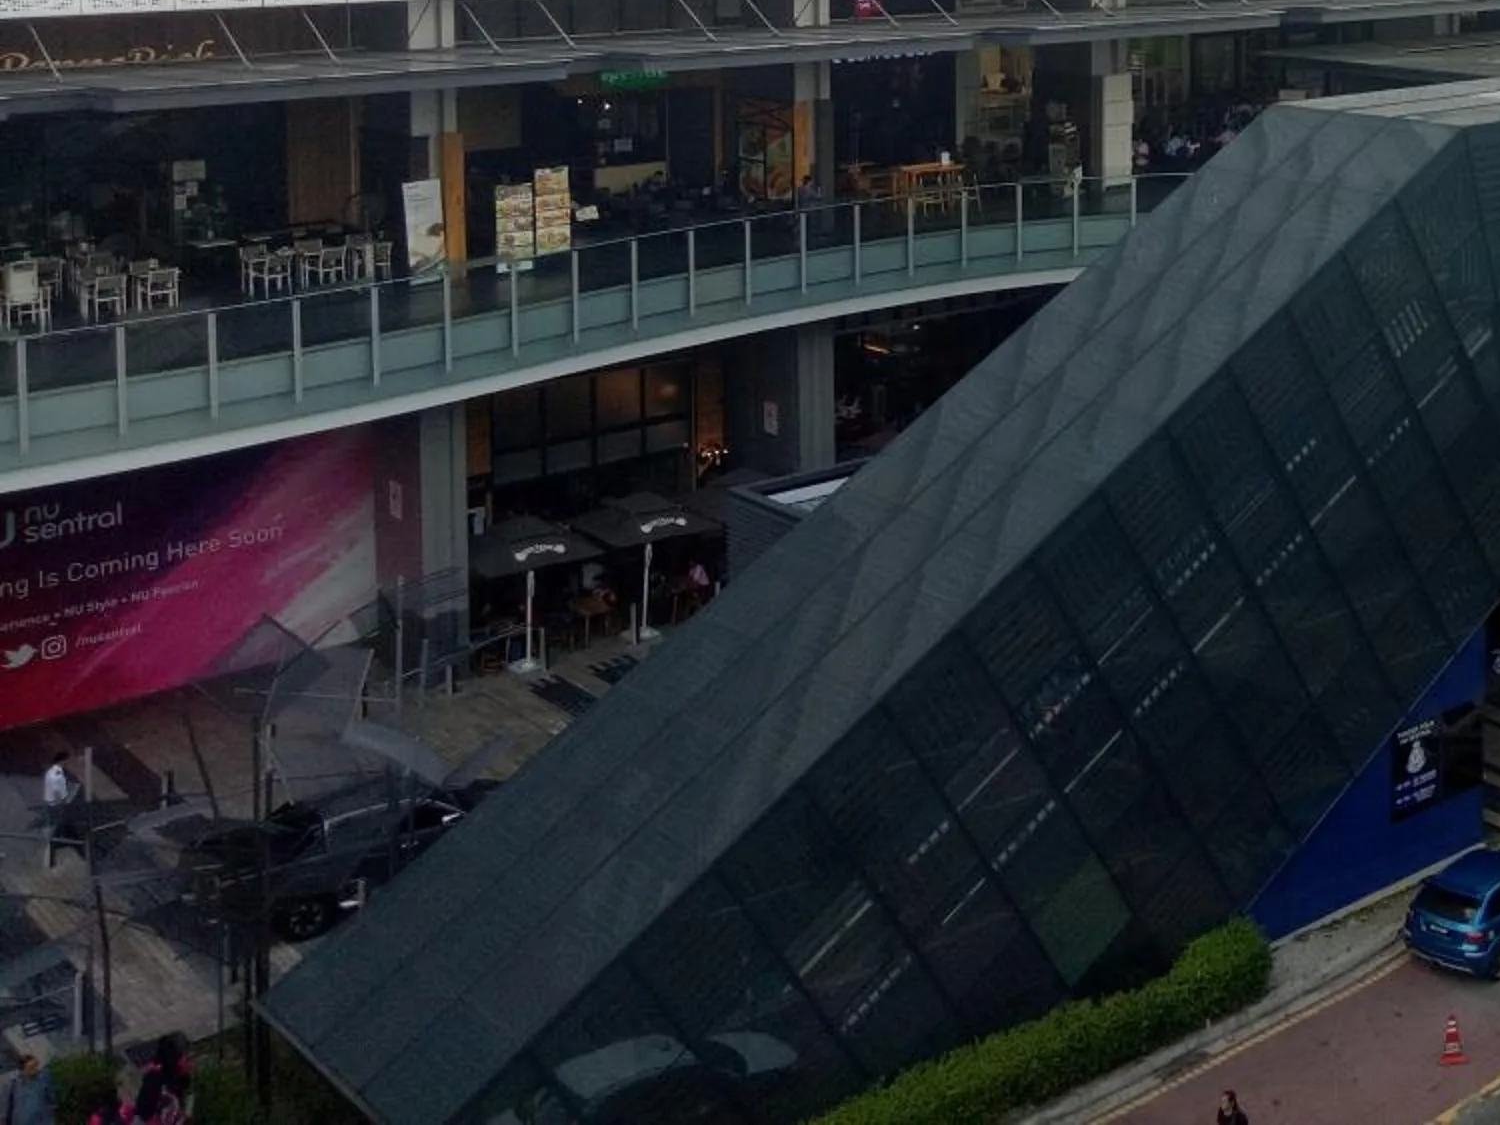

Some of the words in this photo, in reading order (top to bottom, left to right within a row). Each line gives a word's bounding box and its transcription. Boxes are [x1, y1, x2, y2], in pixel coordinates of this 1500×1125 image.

[24, 501, 123, 543] sentral
[38, 569, 59, 588] Is
[67, 550, 159, 582] Coming
[166, 540, 221, 564] Here
[228, 525, 283, 548] Soon
